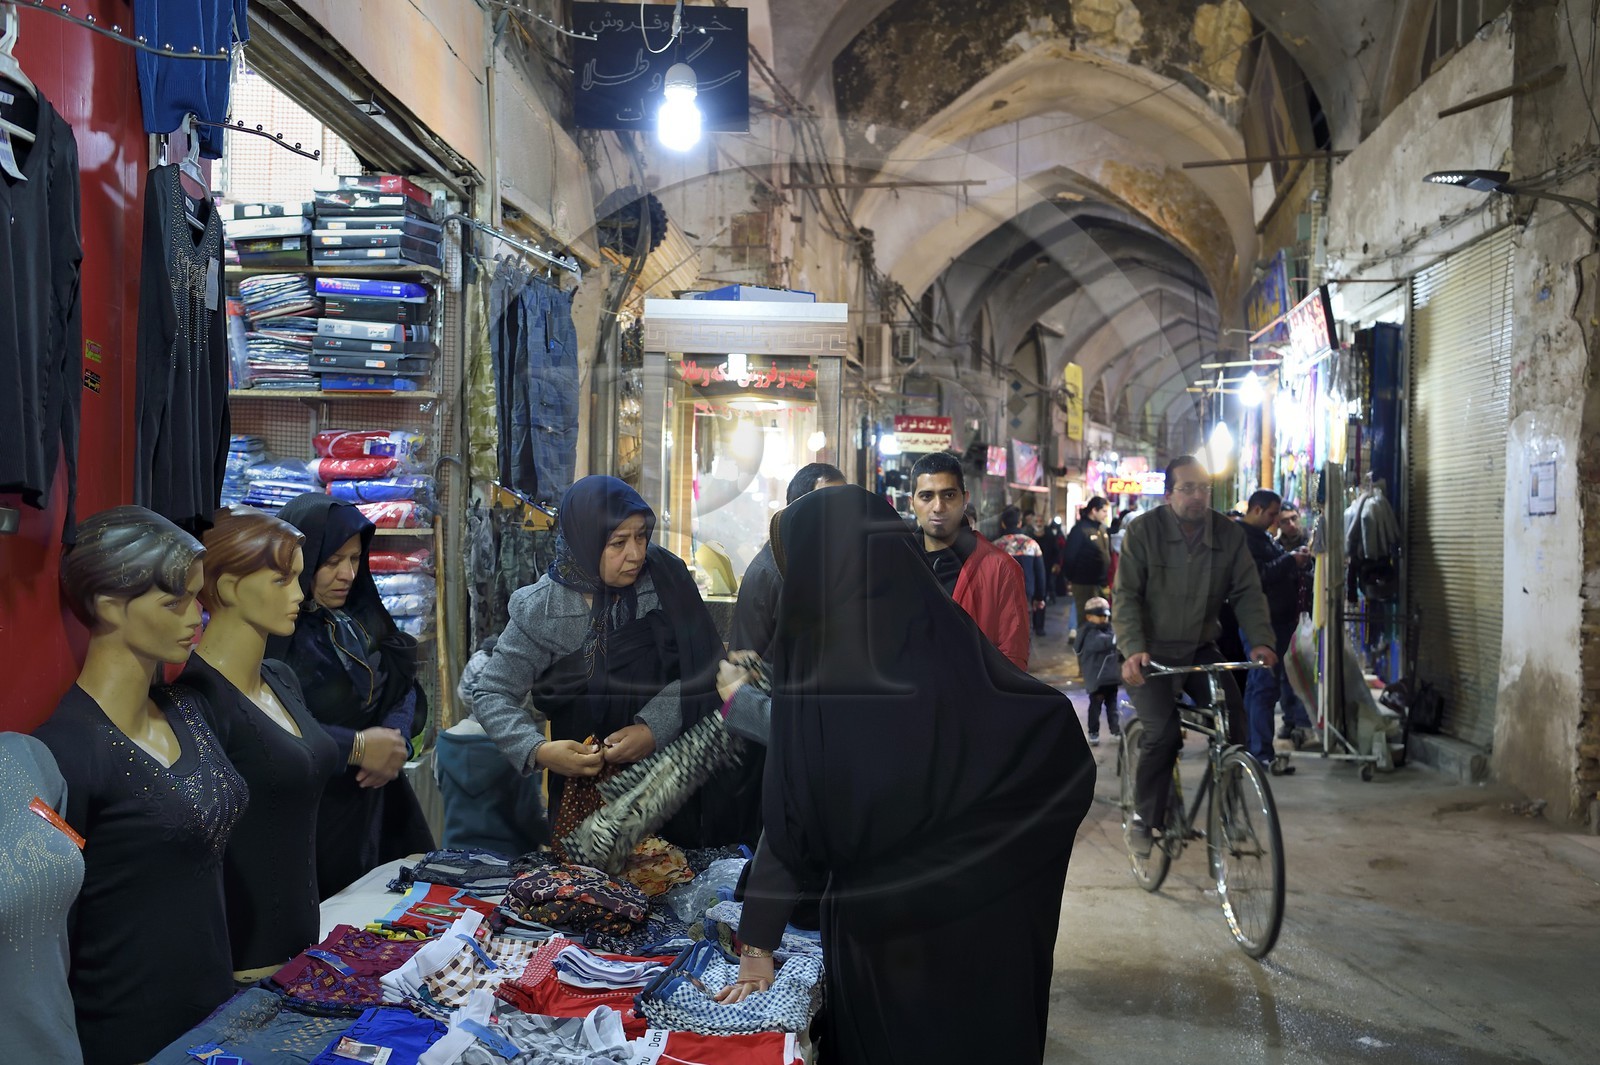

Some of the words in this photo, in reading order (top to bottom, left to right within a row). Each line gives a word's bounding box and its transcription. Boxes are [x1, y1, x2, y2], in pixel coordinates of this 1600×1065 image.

[589, 11, 661, 33] فروش
[676, 15, 733, 34] خری
[581, 48, 650, 91] طلا
[648, 72, 662, 92] و
[680, 360, 702, 381] طلا
[701, 367, 711, 387] و
[737, 361, 778, 388] فروش
[786, 363, 816, 389] خرید
[777, 373, 786, 389] و
[648, 1031, 663, 1048] Dan
